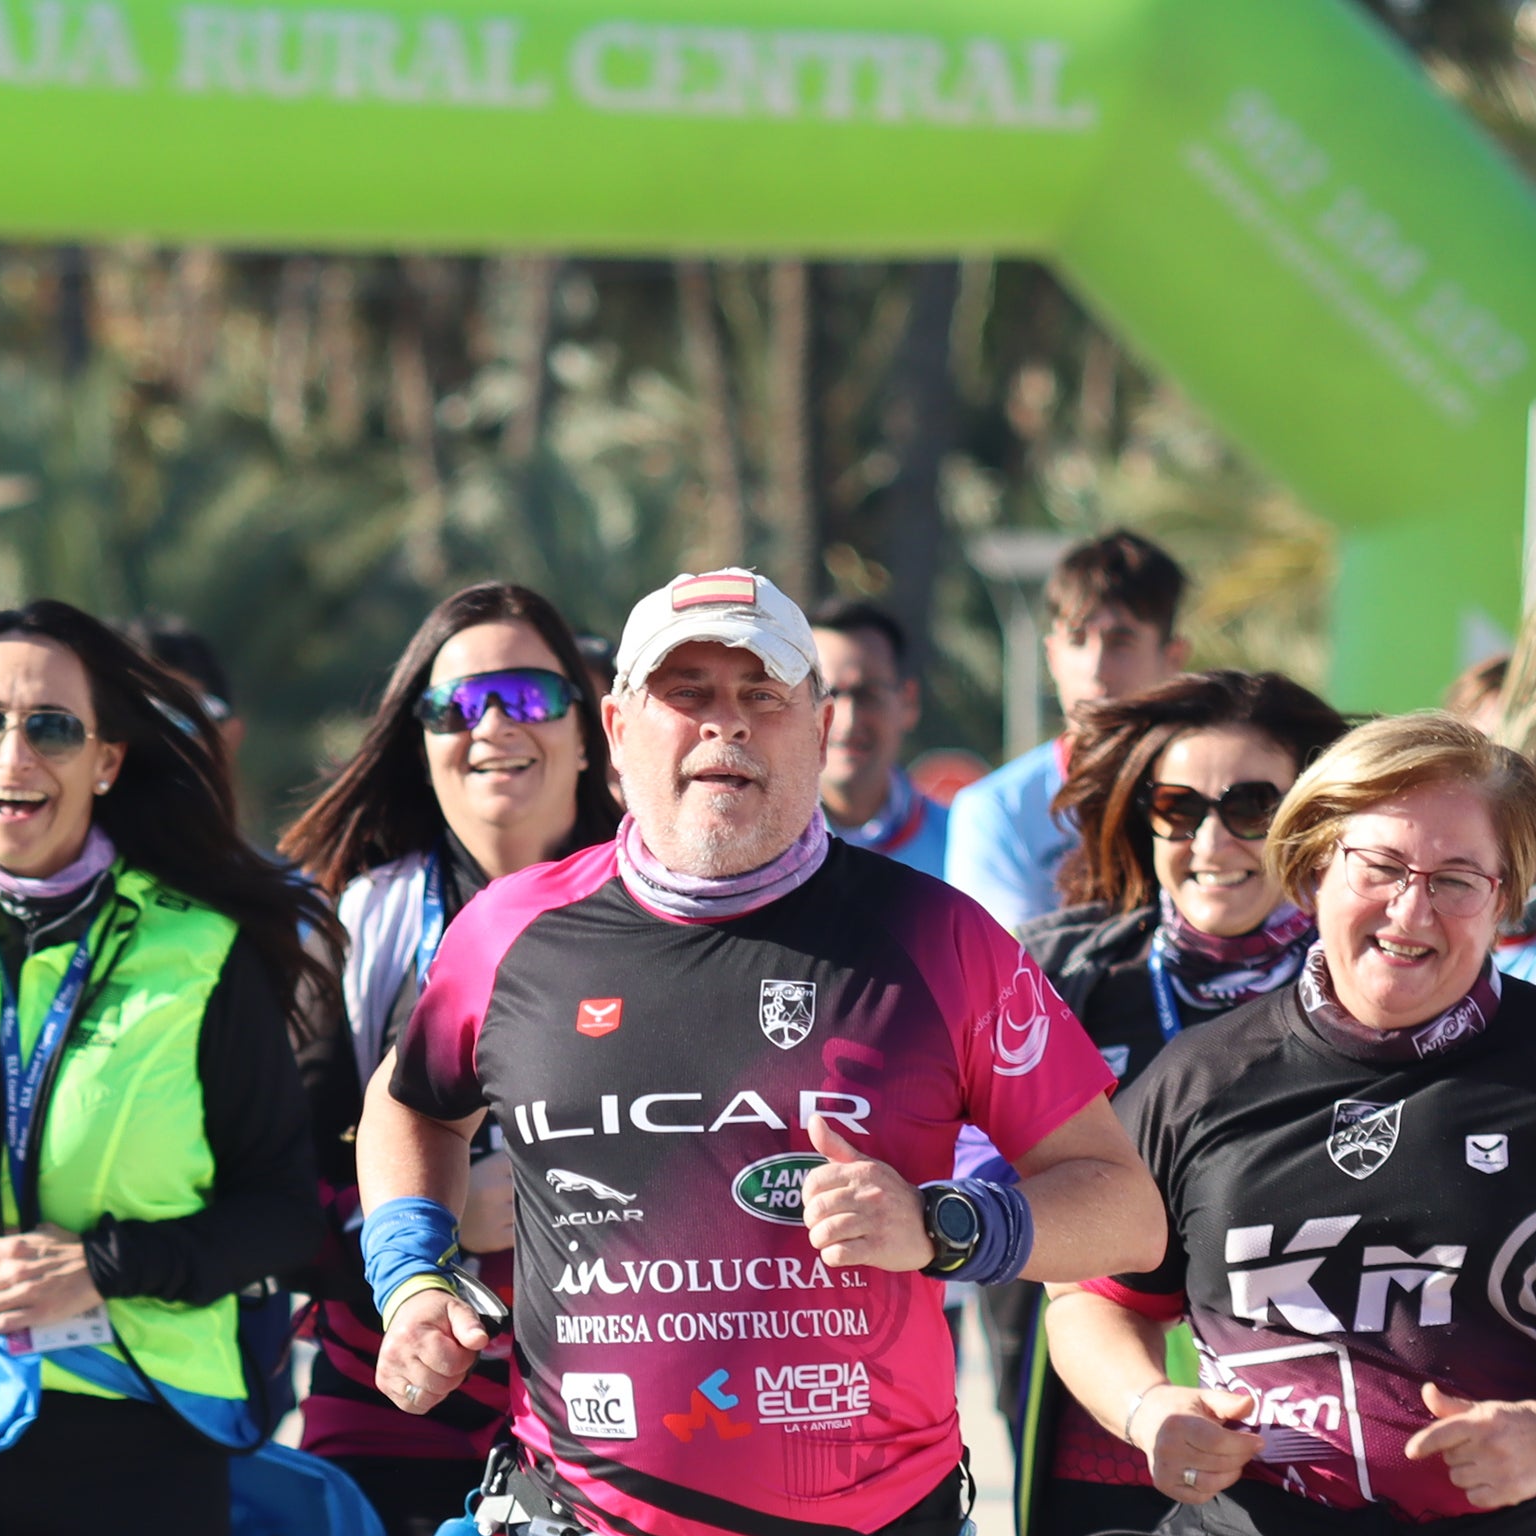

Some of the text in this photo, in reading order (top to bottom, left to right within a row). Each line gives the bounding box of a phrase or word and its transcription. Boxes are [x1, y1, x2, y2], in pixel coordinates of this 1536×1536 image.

[172, 12, 552, 108] RURAL
[566, 24, 1100, 131] CENTRAL
[514, 1090, 872, 1145] ILICAR
[761, 1169, 809, 1190] LAN
[552, 1208, 645, 1228] JAGUAR
[556, 1308, 870, 1345] EMPRESA CONSTRUCTORA
[755, 1361, 870, 1392] MEDIA
[570, 1398, 626, 1425] CRC
[757, 1384, 872, 1417] ELCHE
[810, 1419, 853, 1431] ANTIGUA
